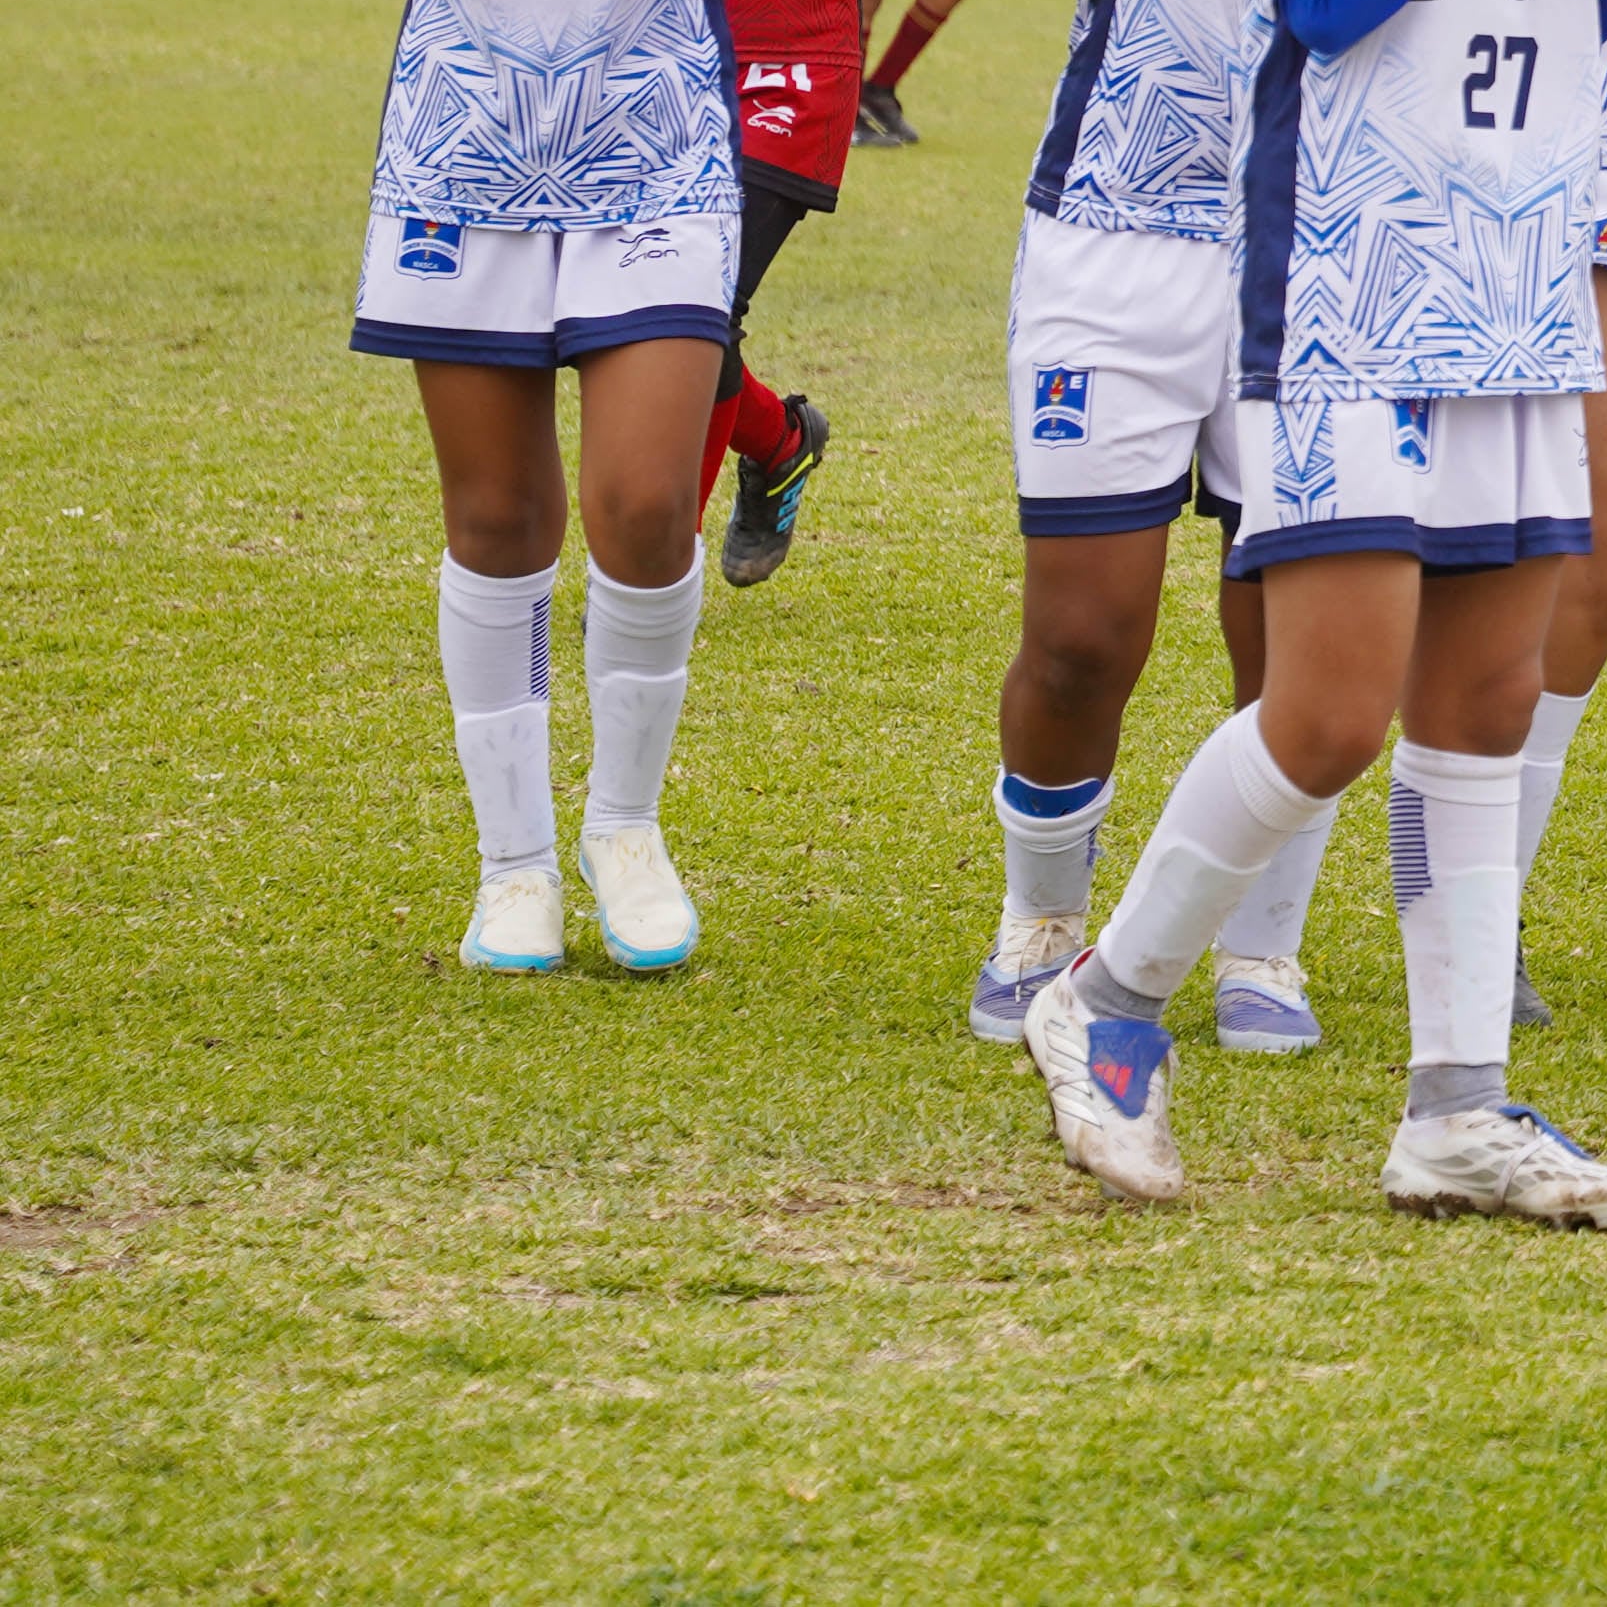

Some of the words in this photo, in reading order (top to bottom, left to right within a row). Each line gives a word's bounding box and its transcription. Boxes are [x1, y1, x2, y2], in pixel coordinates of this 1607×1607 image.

[1463, 34, 1538, 131] 27
[747, 121, 793, 137] orion
[618, 249, 680, 268] orion
[1069, 375, 1084, 390] E
